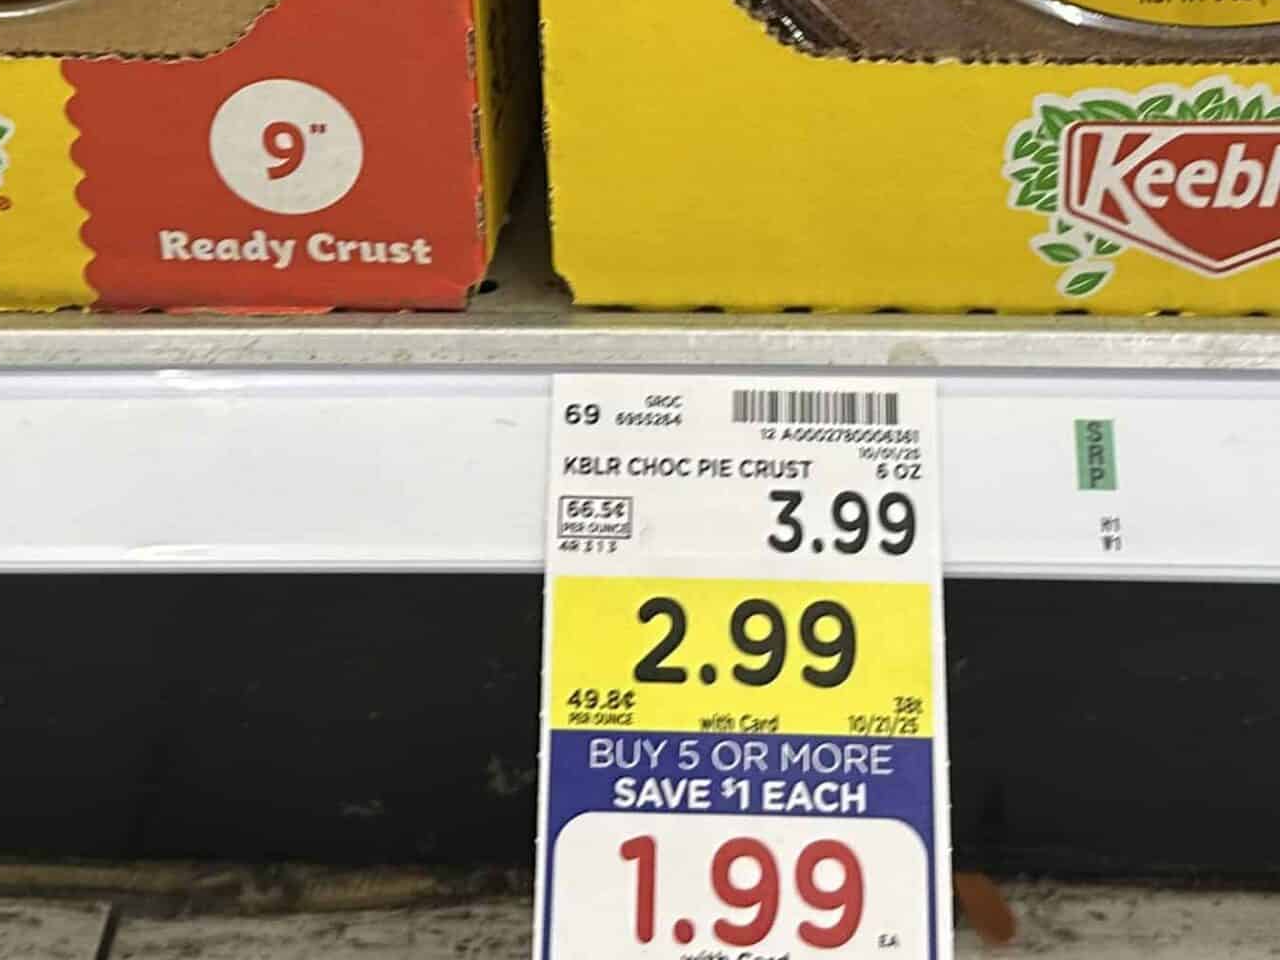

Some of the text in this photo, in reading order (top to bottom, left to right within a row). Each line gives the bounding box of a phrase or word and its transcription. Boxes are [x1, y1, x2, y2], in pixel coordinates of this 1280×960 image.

[262, 121, 326, 180] 9"
[161, 230, 433, 270] Ready Crust
[564, 403, 601, 425] 69
[563, 456, 923, 480] KBLR CHOC PIE CRUST 6 OZ
[1087, 420, 1106, 489] SRP
[566, 489, 918, 556] 66.5¢ 3.99
[632, 596, 857, 689] 2.99
[566, 688, 636, 710] 49.8¢
[699, 715, 738, 733] with
[740, 714, 780, 733] Card
[589, 738, 895, 774] BUY 5 OR MORE
[613, 777, 868, 813] SAVE $1 EACH
[618, 834, 865, 950] 1.99
